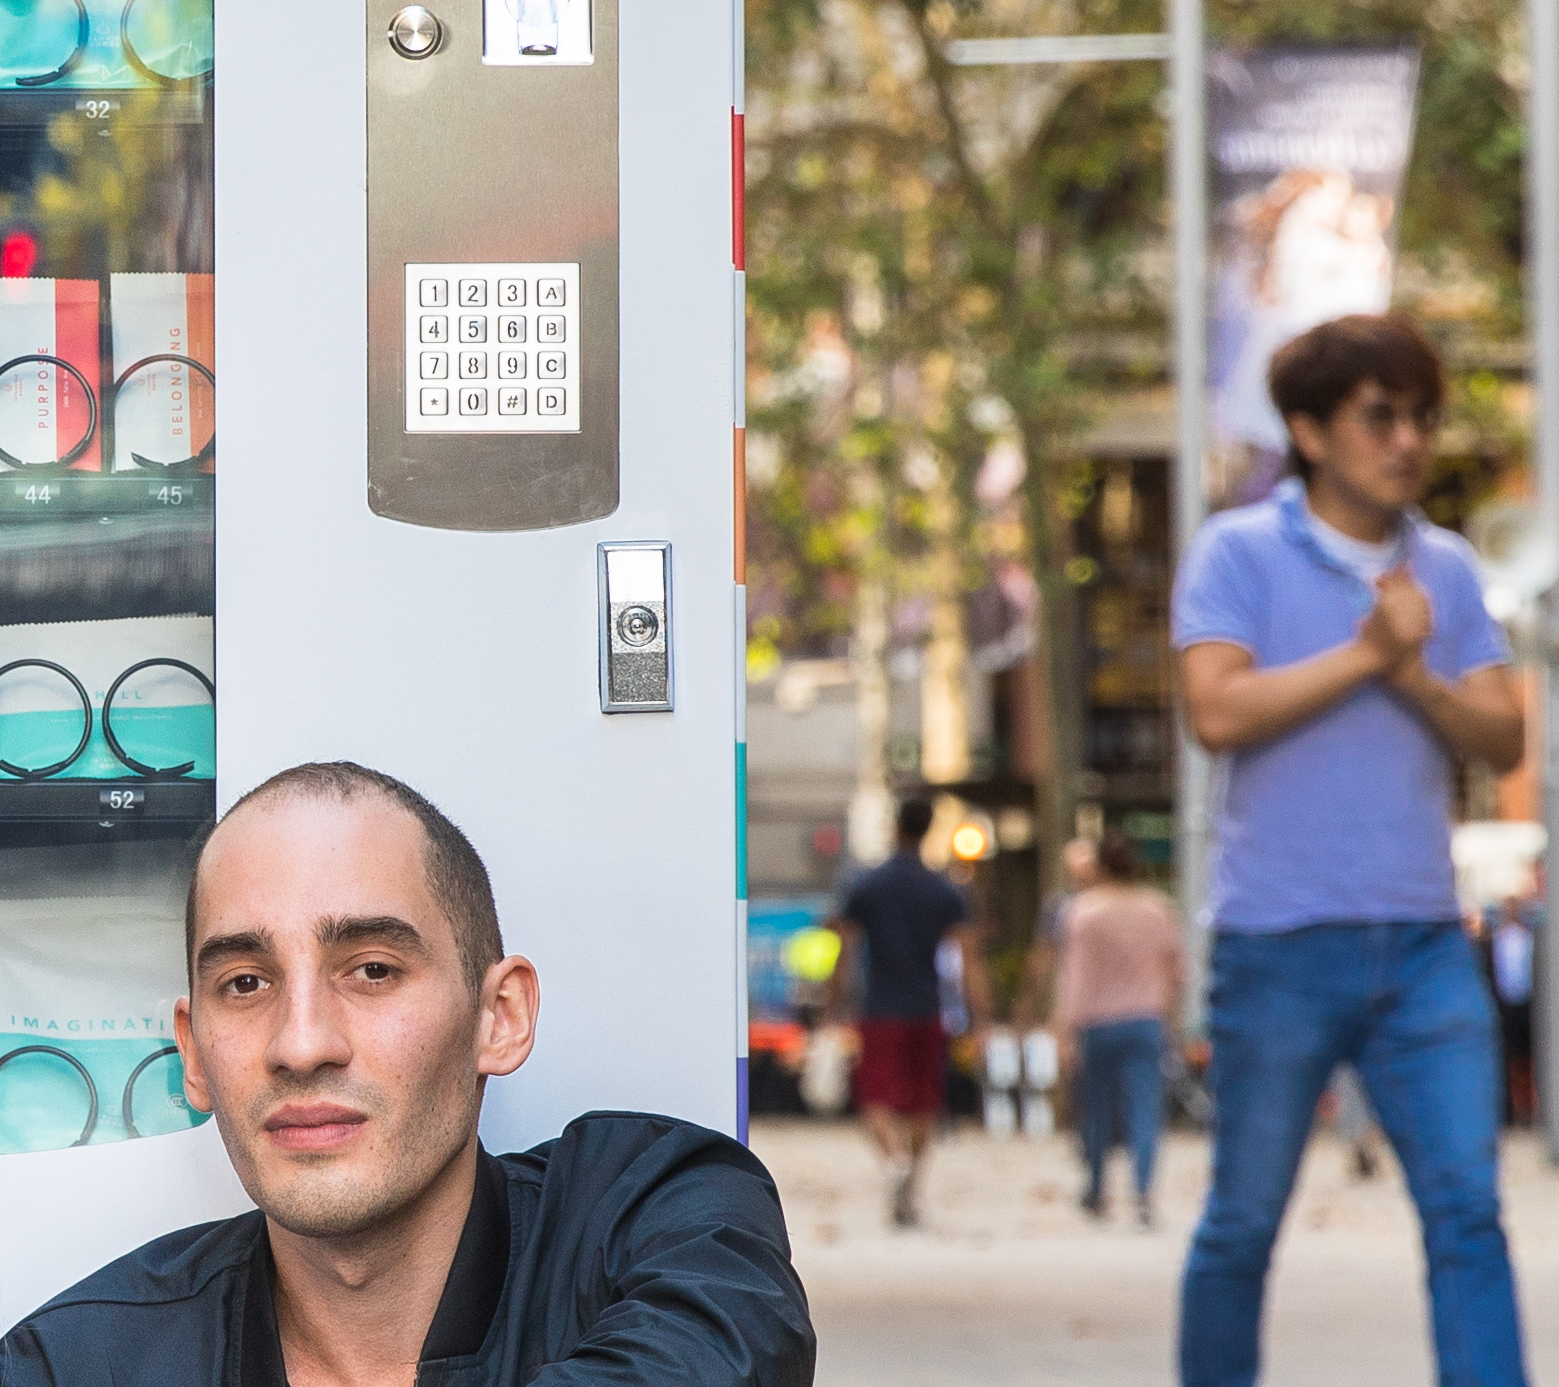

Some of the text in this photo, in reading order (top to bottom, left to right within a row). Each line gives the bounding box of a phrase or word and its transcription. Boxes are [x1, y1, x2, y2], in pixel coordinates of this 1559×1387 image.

[85, 100, 111, 119] 32
[432, 285, 557, 302] 1 2 3 A
[429, 321, 557, 338] 4 5 6 B
[430, 357, 557, 374] 7 8 9 C
[169, 327, 183, 435] BELONGNG
[467, 393, 557, 410] 0 # D
[24, 485, 51, 504] 44
[157, 485, 183, 505] 45
[110, 791, 135, 809] 52
[11, 1014, 165, 1032] IMAGINATI
